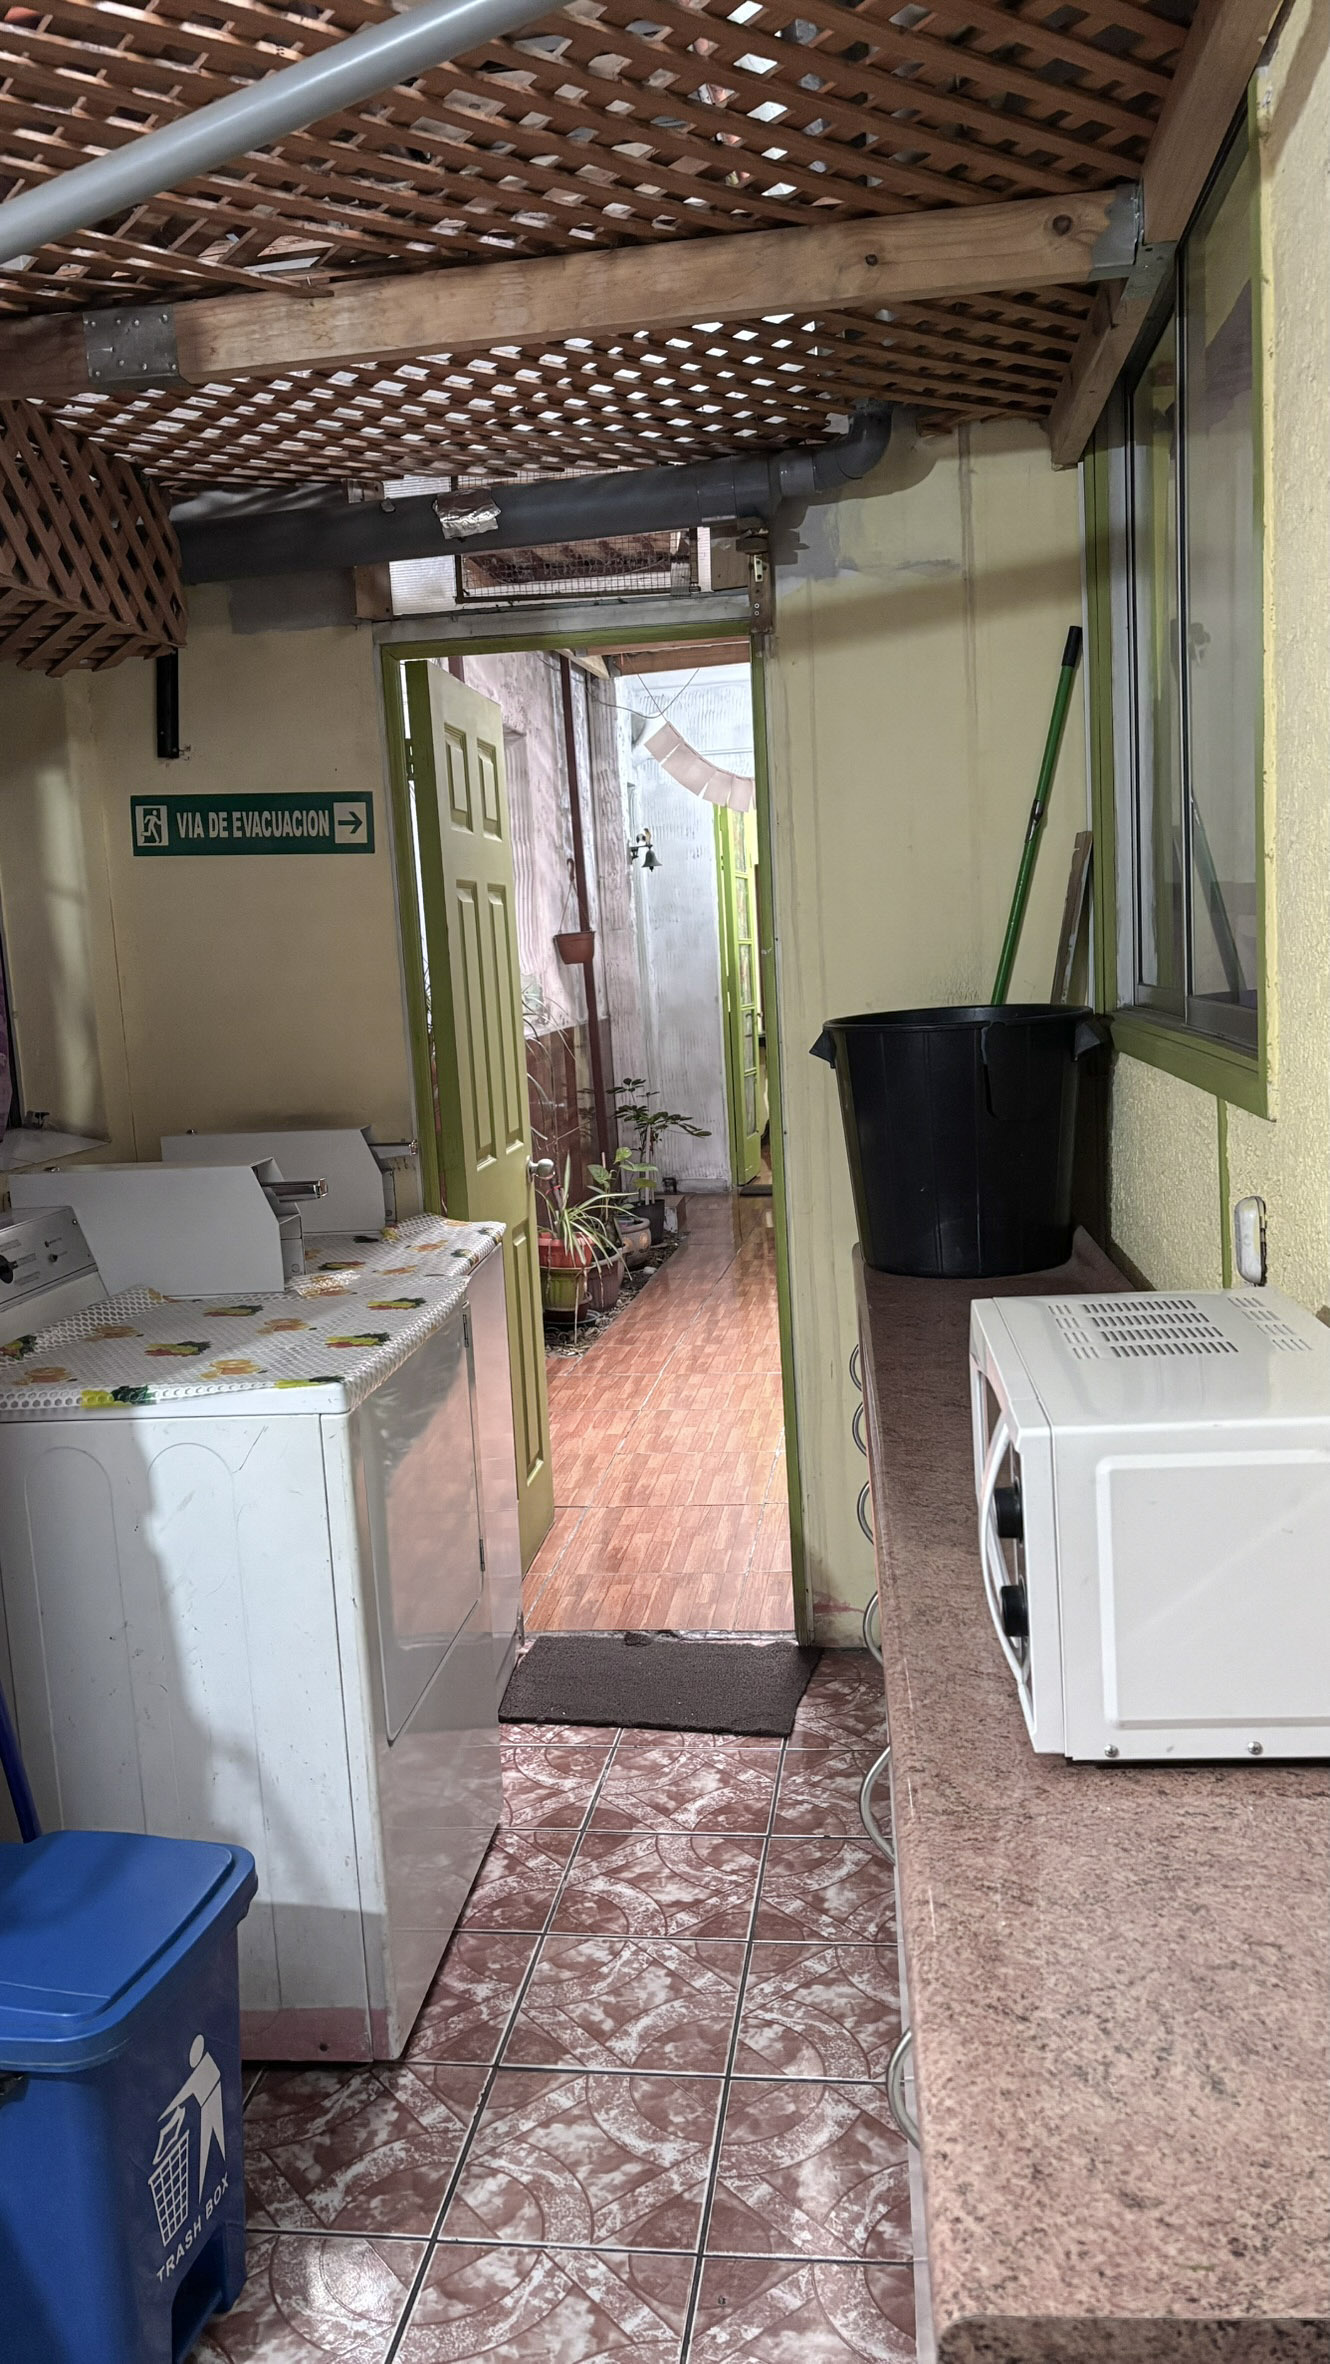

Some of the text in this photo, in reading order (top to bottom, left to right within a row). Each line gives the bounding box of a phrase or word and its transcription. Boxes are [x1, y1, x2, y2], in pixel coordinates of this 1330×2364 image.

[176, 809, 330, 838] VIA DE EVACUACION
[156, 2171, 229, 2283] TRASH BOX
